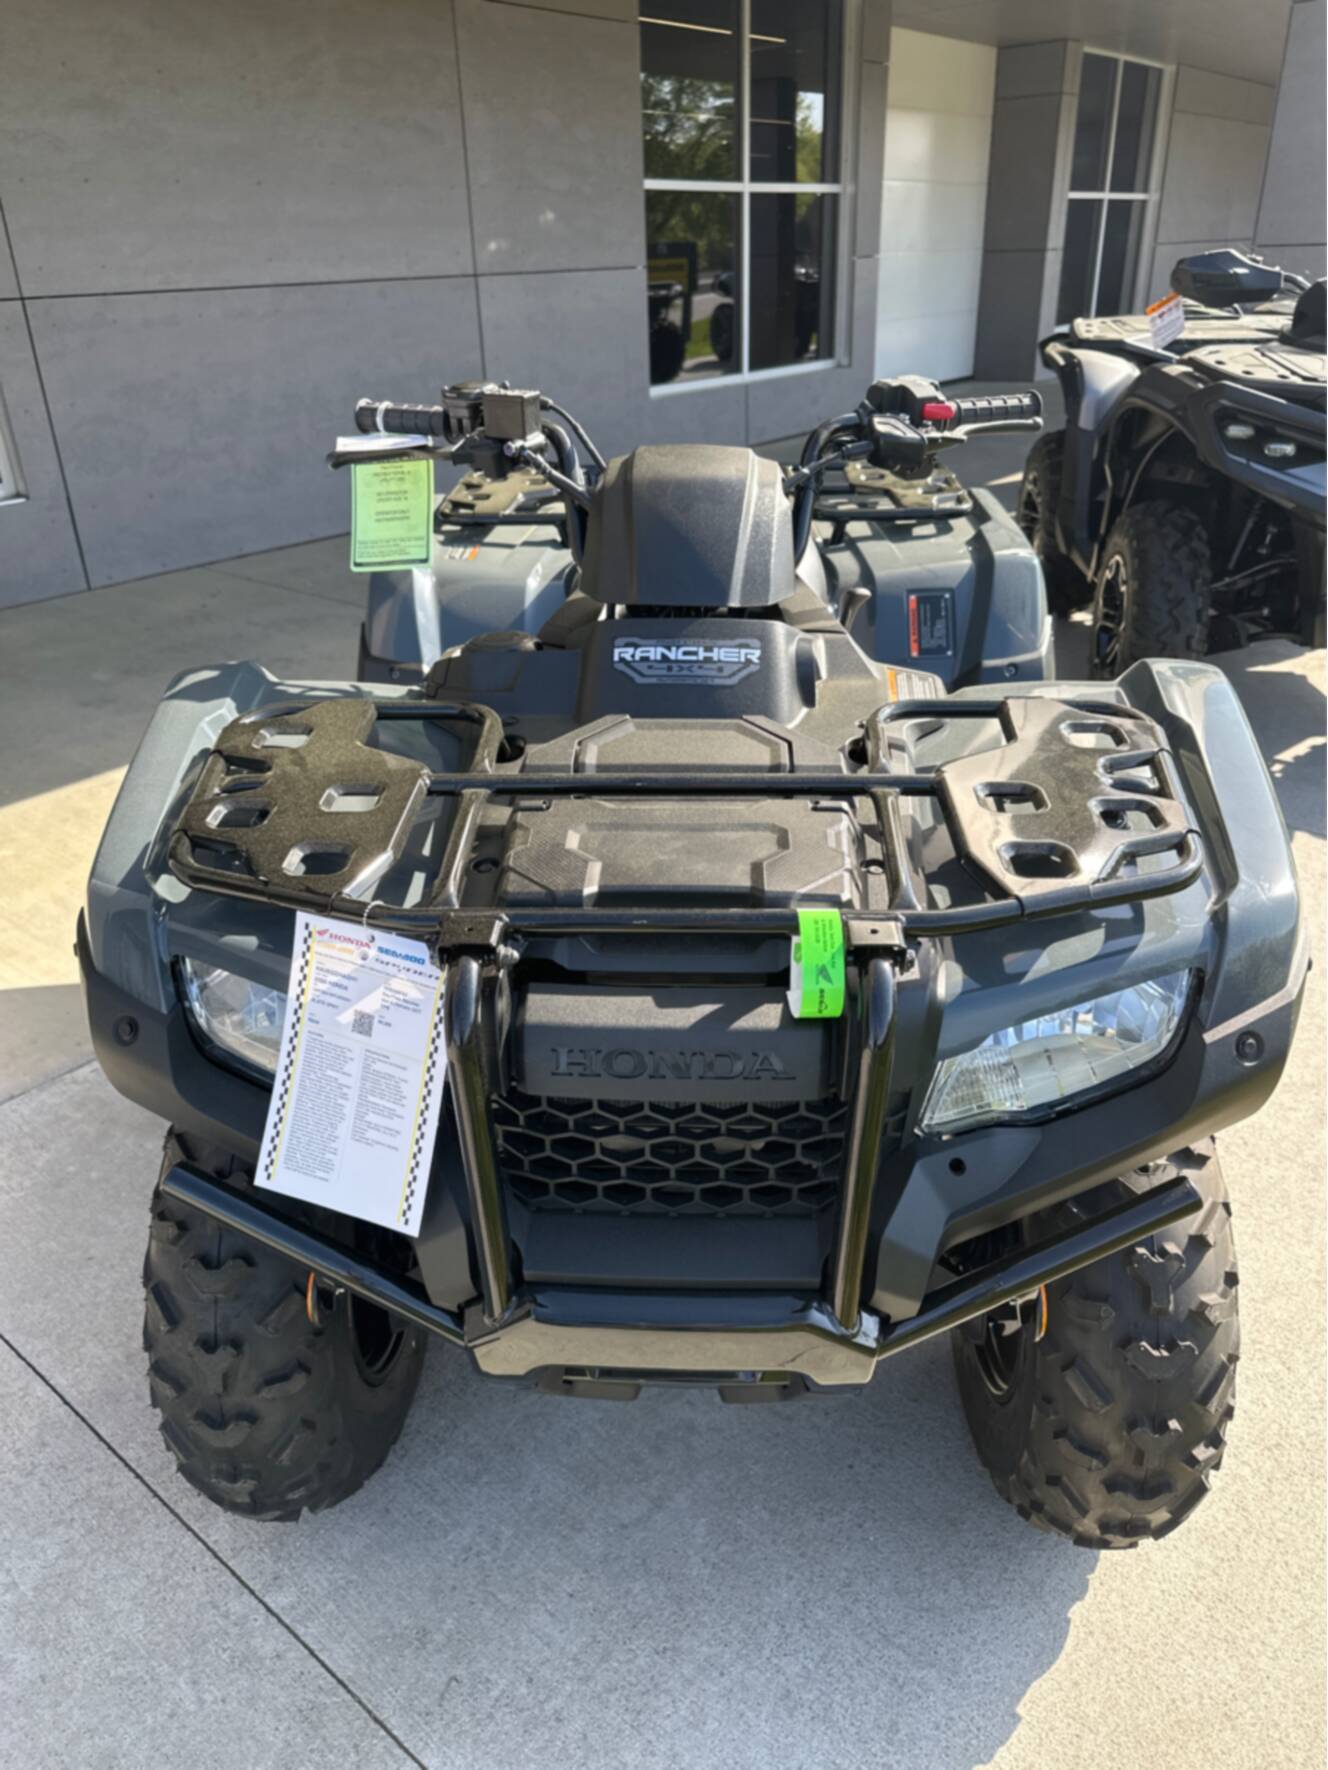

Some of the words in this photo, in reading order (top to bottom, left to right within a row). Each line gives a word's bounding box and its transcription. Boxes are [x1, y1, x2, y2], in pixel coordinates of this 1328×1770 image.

[614, 647, 761, 663] RANCHER
[329, 933, 372, 948] HONDA
[551, 1048, 796, 1080] HONDA
